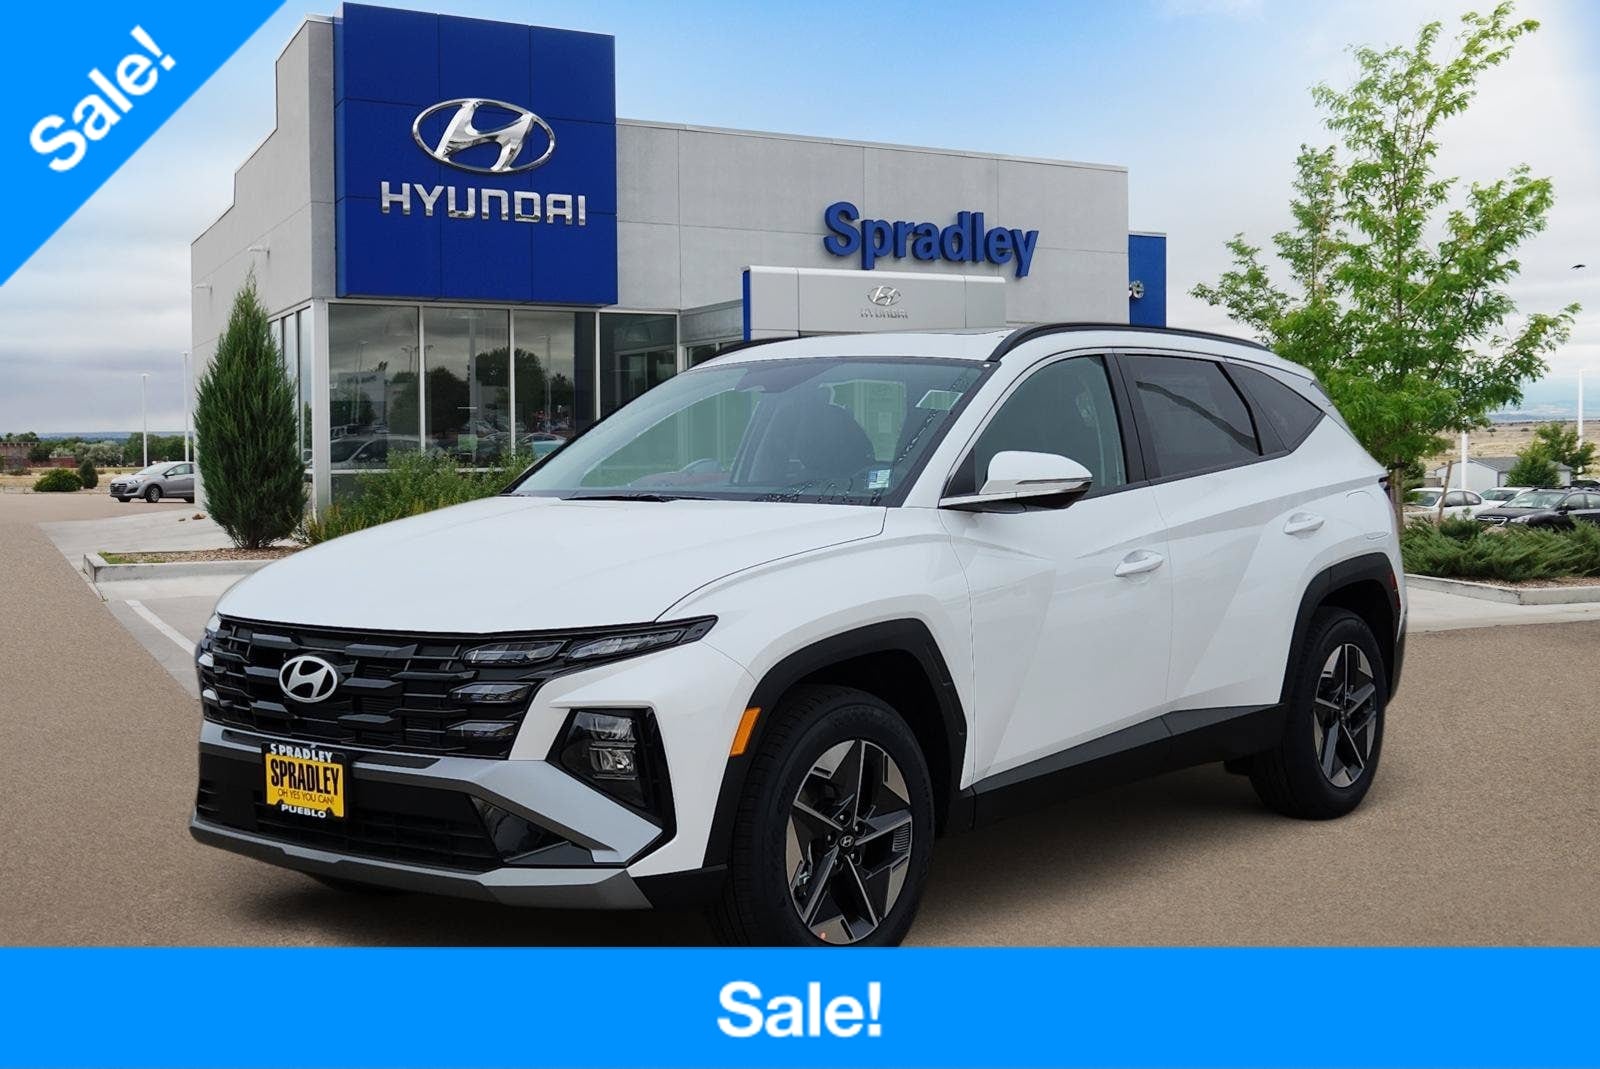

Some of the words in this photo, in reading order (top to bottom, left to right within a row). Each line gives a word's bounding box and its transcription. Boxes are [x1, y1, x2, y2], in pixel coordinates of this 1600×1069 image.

[381, 181, 586, 226] HYUNDAI
[823, 201, 1039, 279] Spradley
[270, 743, 333, 763] SPRADLEY
[270, 758, 340, 796] SPRADLEY
[278, 788, 288, 798] OH
[290, 790, 300, 800] YES
[302, 792, 317, 802] YOU
[281, 803, 327, 818] PUEBLO
